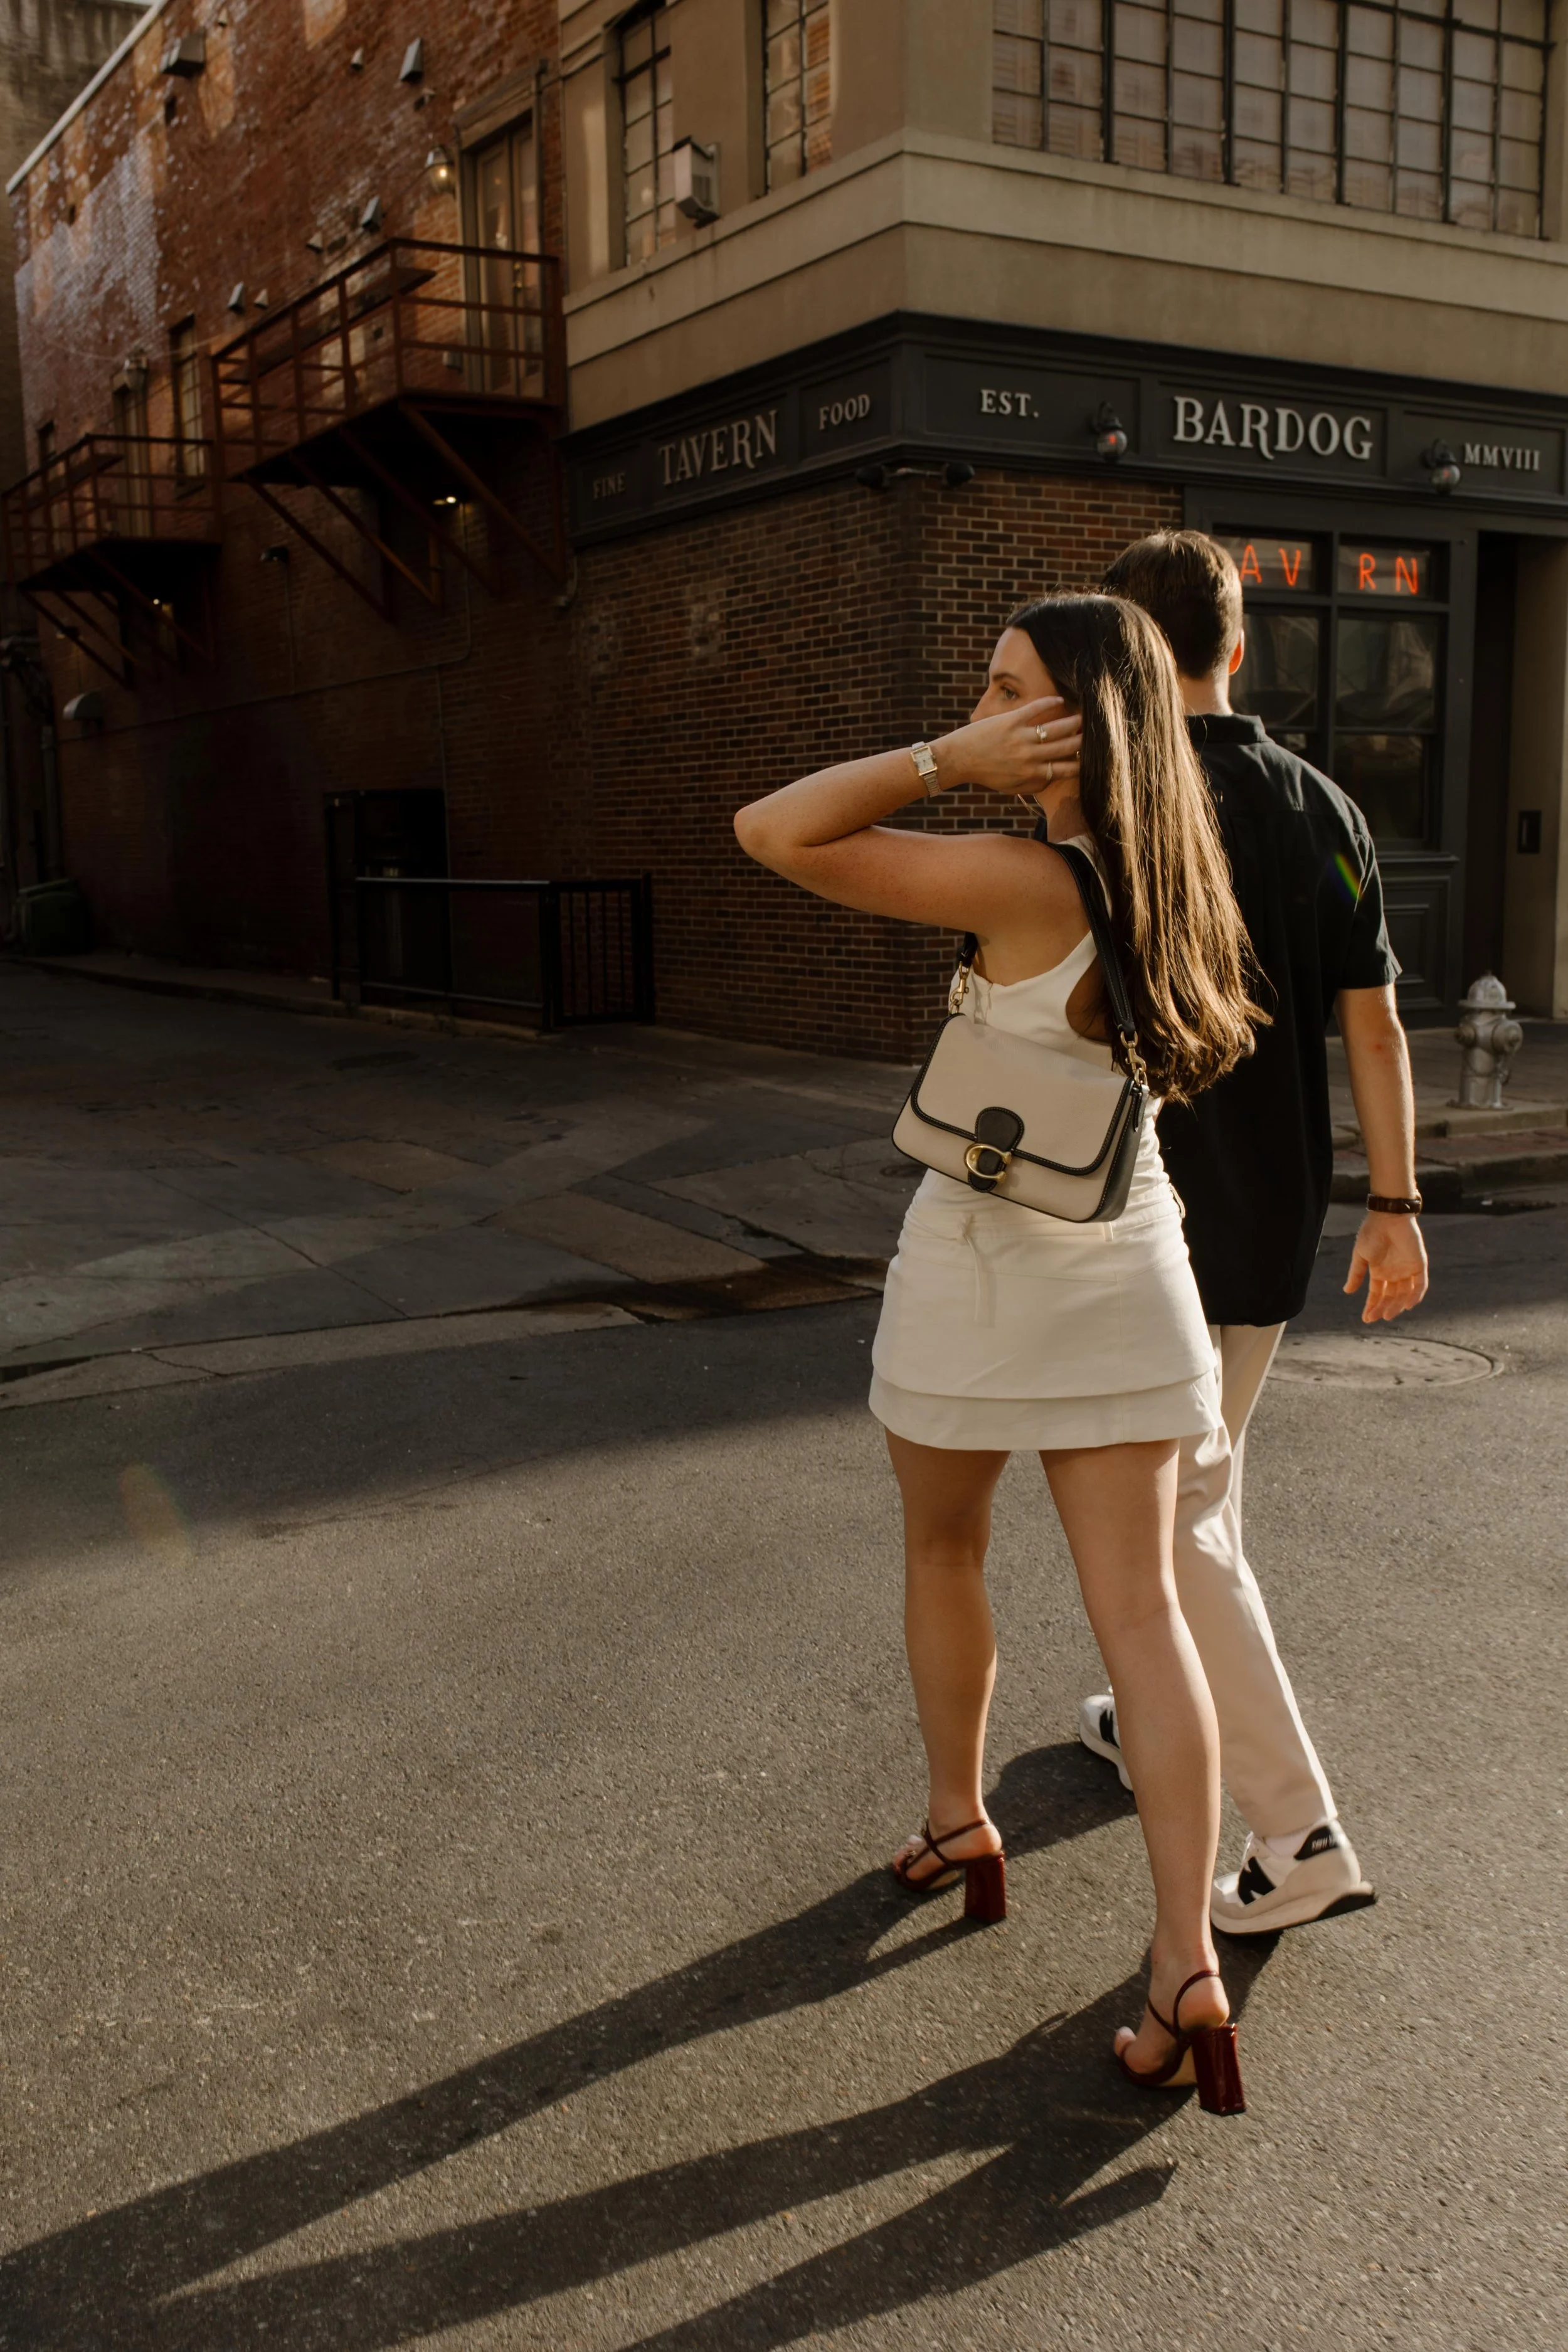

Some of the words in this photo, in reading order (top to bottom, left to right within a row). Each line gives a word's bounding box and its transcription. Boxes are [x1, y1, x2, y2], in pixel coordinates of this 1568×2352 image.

[593, 472, 625, 500] FINE
[659, 410, 778, 485] TAVERN
[818, 393, 871, 430] FOOD
[980, 389, 1039, 418] EST.
[1173, 396, 1373, 460] BARDOG
[1464, 442, 1540, 471] MMVIII
